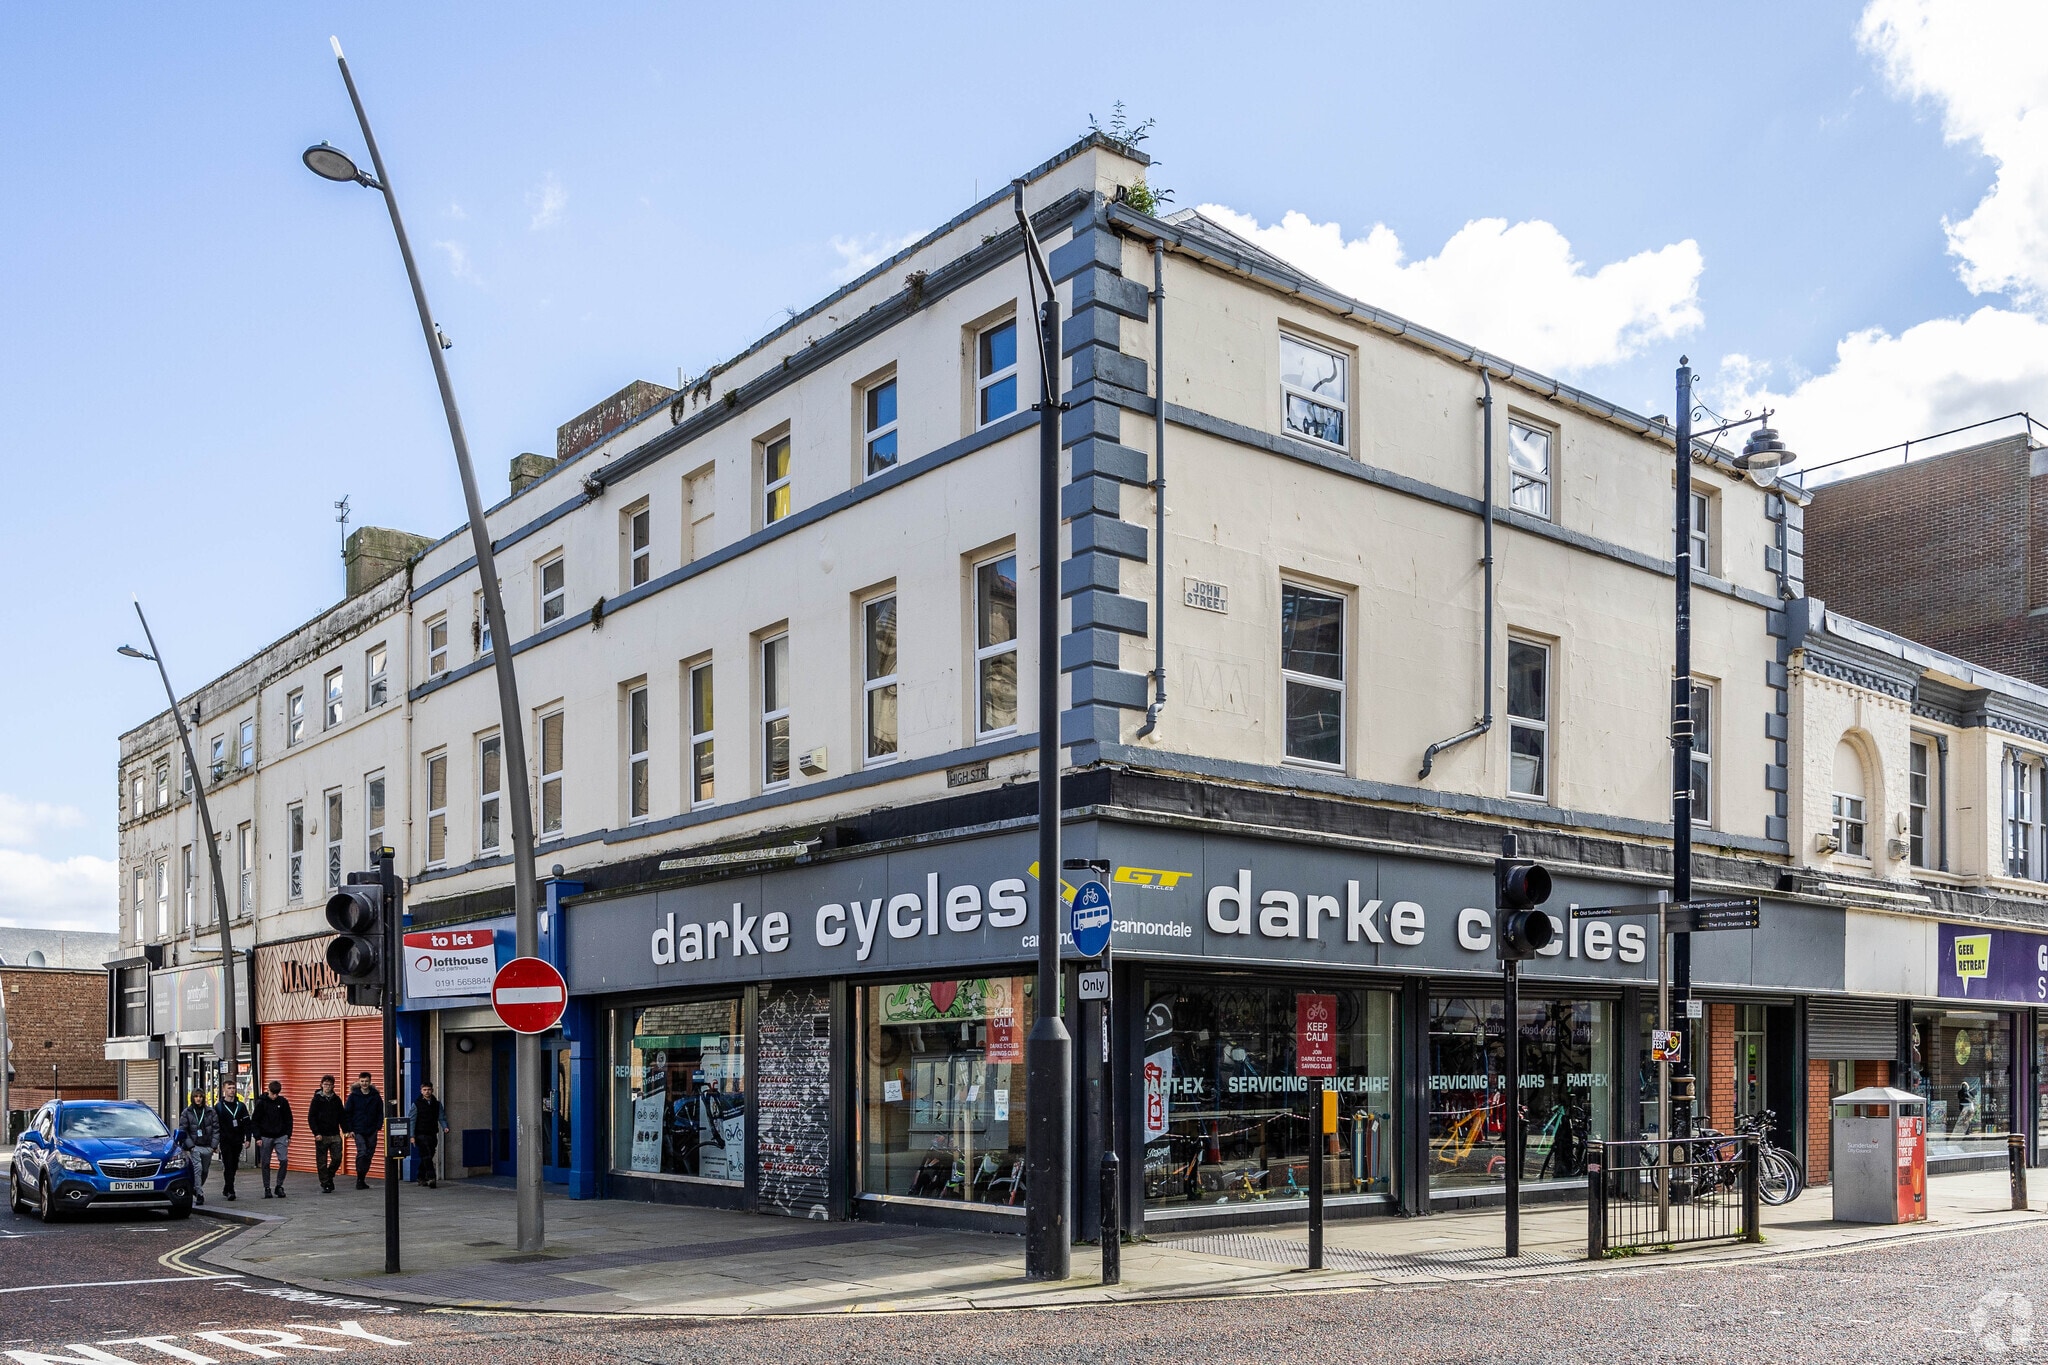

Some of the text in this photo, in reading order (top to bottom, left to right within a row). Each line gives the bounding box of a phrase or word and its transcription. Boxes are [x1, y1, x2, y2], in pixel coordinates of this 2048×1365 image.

[1193, 582, 1220, 598] JOHN
[1187, 592, 1226, 610] STREET
[949, 770, 969, 786] HIGH
[1114, 866, 1193, 887] GT
[1142, 884, 1175, 892] BICYCLES
[651, 872, 1028, 966] darke cycles
[1206, 869, 1646, 964] darke ccles
[1112, 919, 1192, 938] cannondale
[431, 933, 474, 947] to let
[1958, 944, 1974, 956] GEEK
[433, 956, 489, 967] lofthouse
[1958, 959, 1985, 972] RETREAT
[446, 965, 469, 973] partners
[435, 977, 491, 988] 0191 5658844
[1082, 978, 1105, 993] Only
[995, 1007, 1014, 1017] KEEP
[994, 1018, 1014, 1028] CALM
[1307, 1022, 1328, 1032] KEEP
[1306, 1032, 1328, 1042] CALM
[1653, 1041, 1666, 1050] FEST
[615, 1065, 647, 1078] REPAIRS
[1228, 1076, 1308, 1093] SERVICING
[1322, 1076, 1355, 1092] BIKE
[1360, 1076, 1390, 1092] HIRE
[1498, 1073, 1545, 1089] RAIRS
[1566, 1073, 1608, 1087] PART-EX
[1898, 1137, 1917, 1147] FAVOURITE
[1898, 1147, 1913, 1157] TYPE OF
[115, 1182, 133, 1190] DY16
